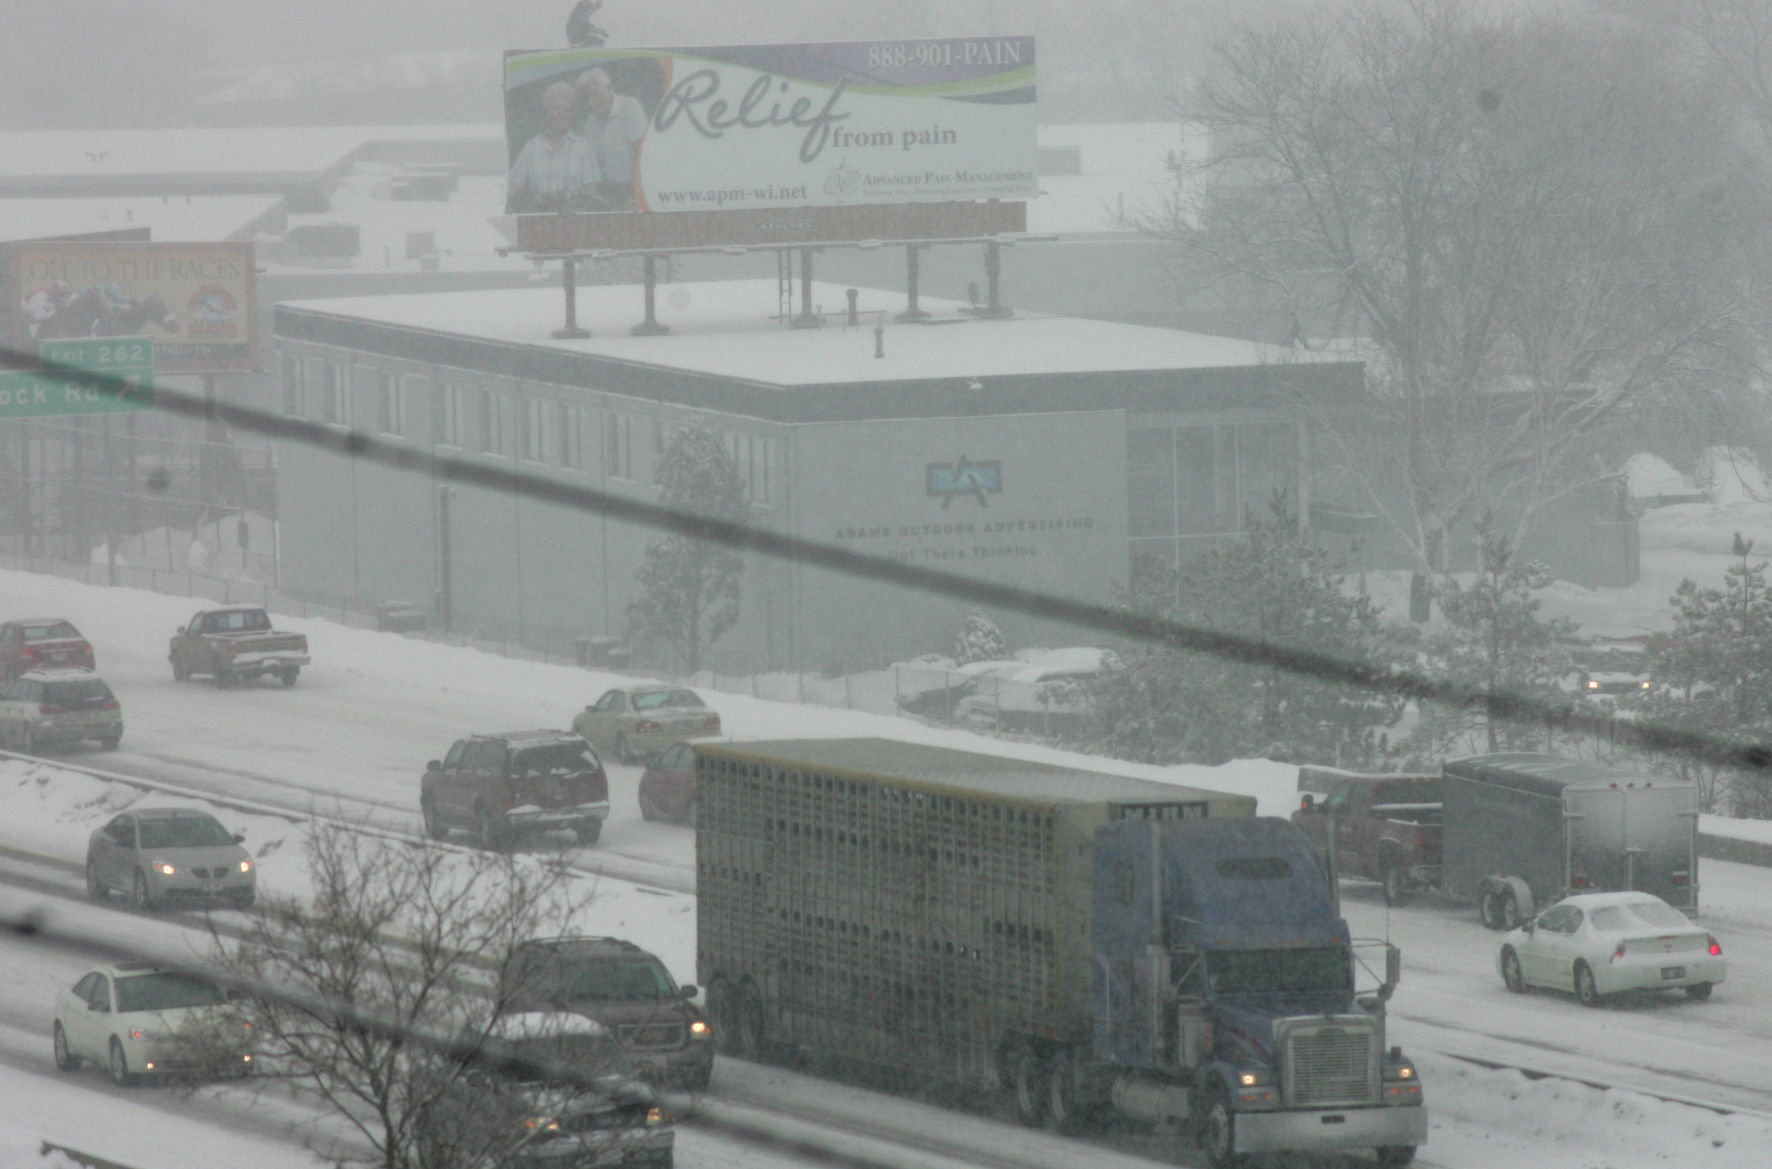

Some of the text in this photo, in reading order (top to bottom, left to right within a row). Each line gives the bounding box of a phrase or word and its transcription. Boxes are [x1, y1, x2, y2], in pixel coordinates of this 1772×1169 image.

[867, 40, 1022, 68] 888-901-PAIN
[654, 69, 851, 163] Relief
[832, 125, 957, 151] from pain
[924, 171, 952, 184] PAIN
[955, 170, 1034, 183] MANAGEMENT
[656, 184, 808, 205] www.apm-wi.net
[29, 257, 240, 281] OFF TO THE RACES
[51, 350, 85, 362] EXIT
[98, 344, 144, 364] 262
[835, 517, 1095, 539] ADAMS OUTDOOR ADVERTISING
